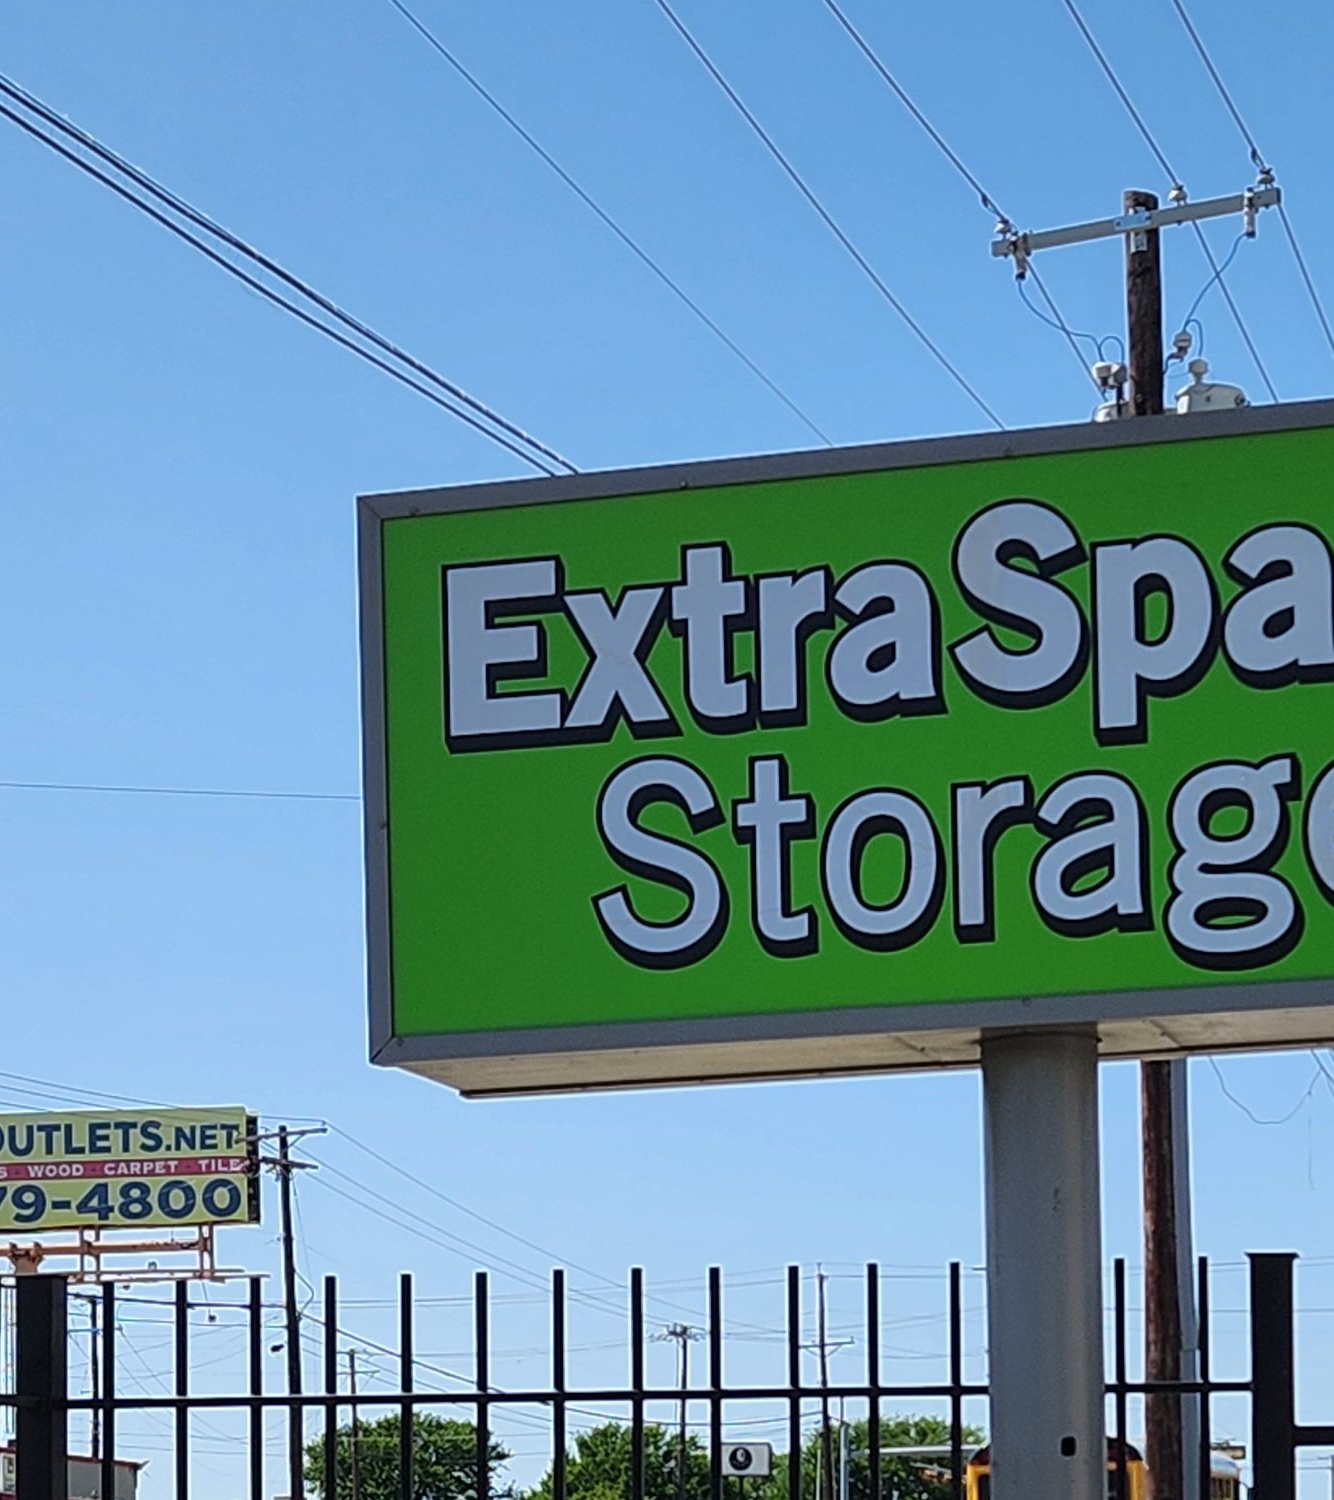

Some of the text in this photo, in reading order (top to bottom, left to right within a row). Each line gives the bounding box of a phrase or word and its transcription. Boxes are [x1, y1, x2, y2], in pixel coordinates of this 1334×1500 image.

[28, 1164, 84, 1179] WOOD
[104, 1161, 178, 1176] CARPET
[197, 1159, 241, 1173] TILE
